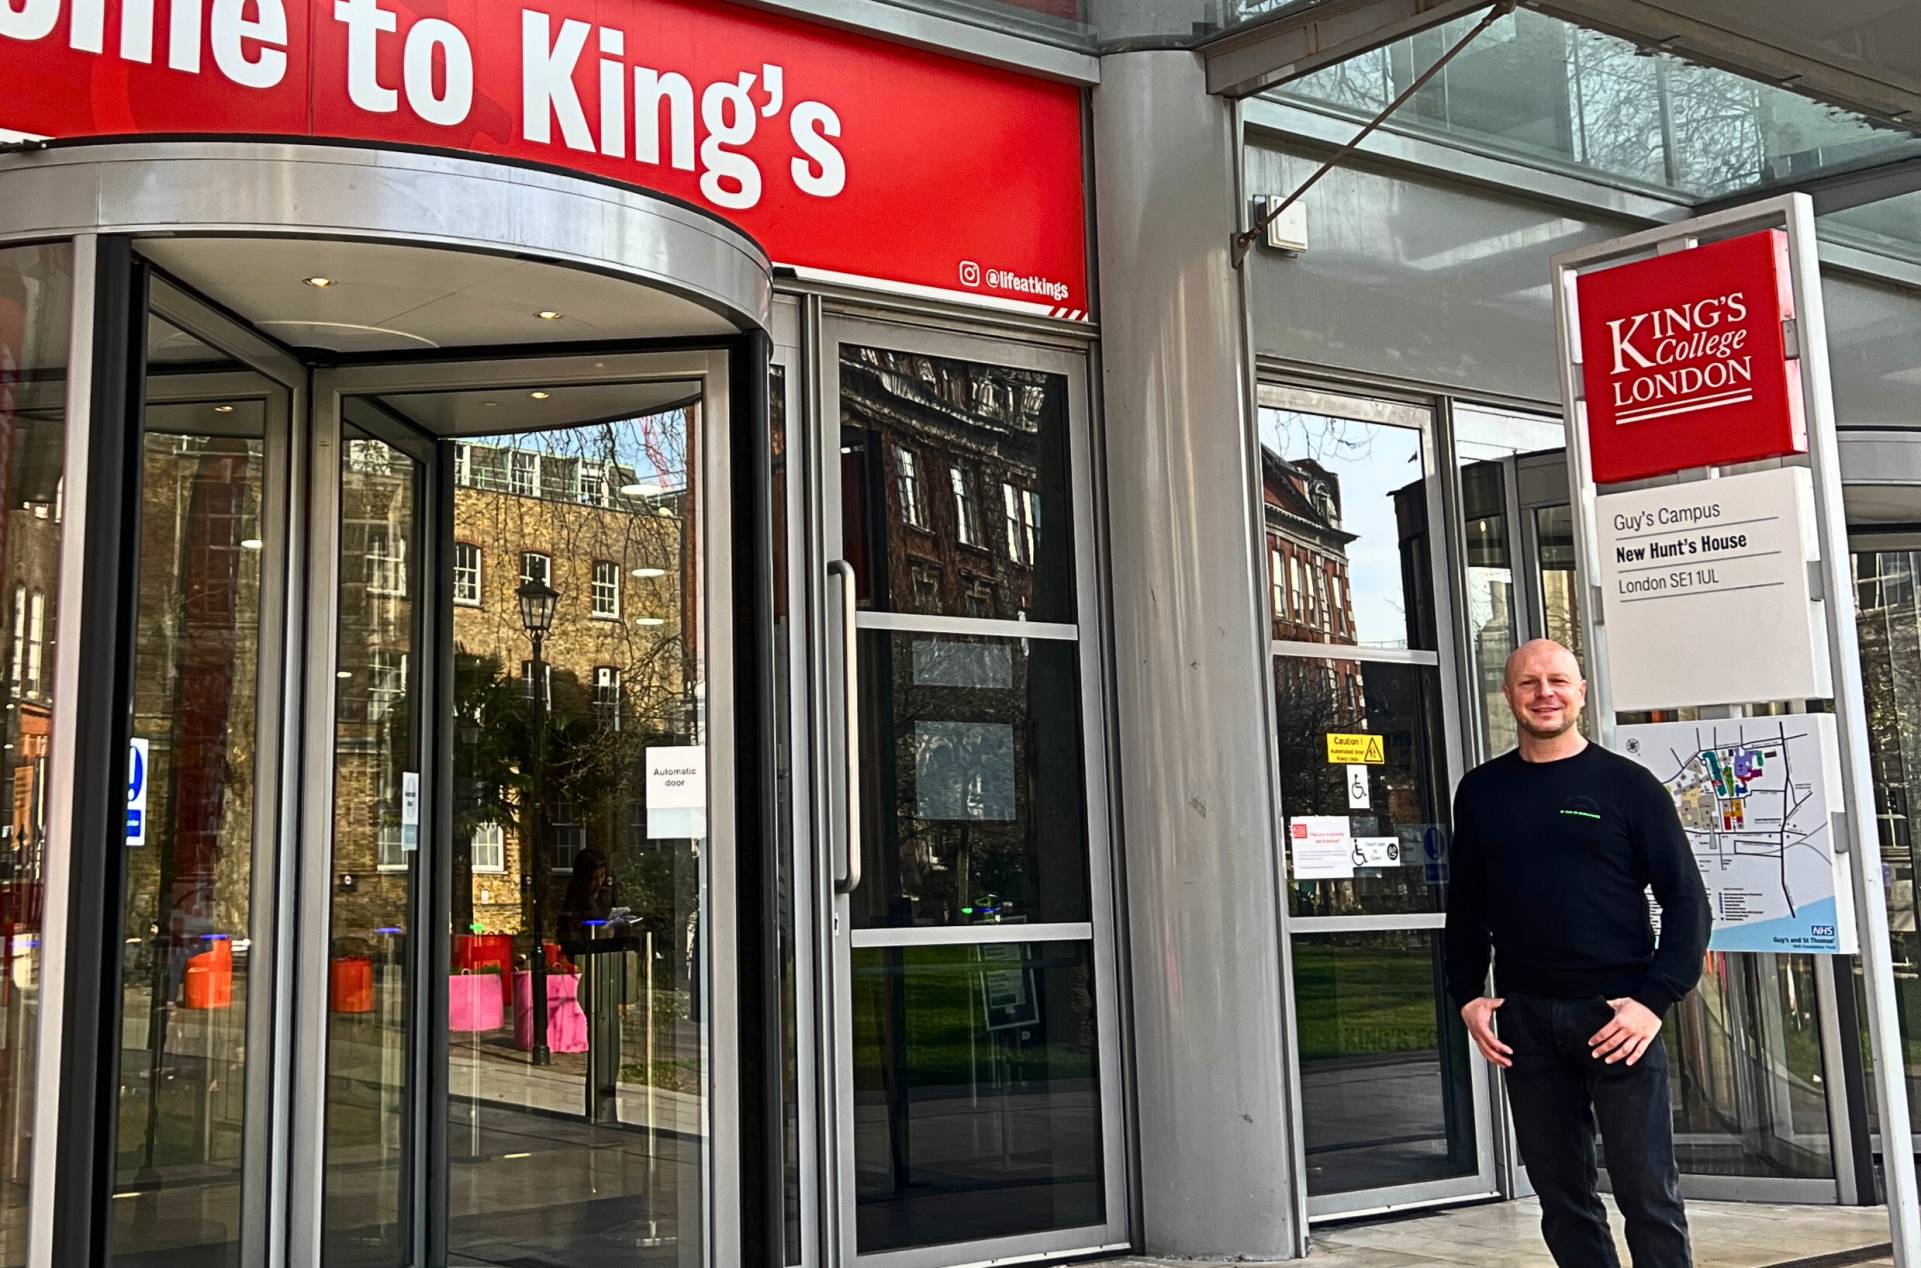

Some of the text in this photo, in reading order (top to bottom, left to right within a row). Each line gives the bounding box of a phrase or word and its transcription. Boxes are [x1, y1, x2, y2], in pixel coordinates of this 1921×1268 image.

[332, 0, 473, 126] to
[521, 8, 846, 210] King's
[986, 268, 1069, 301] @lifeatkings
[1605, 291, 1748, 375] KING'S
[1655, 328, 1748, 366] College
[1612, 356, 1753, 407] LONDON
[1613, 503, 1721, 532] Guy's Campus
[1615, 533, 1747, 564] New Hunt's House
[1618, 568, 1720, 595] London SE1 1UL
[653, 768, 696, 776] Automatic
[1813, 926, 1832, 935] NHS
